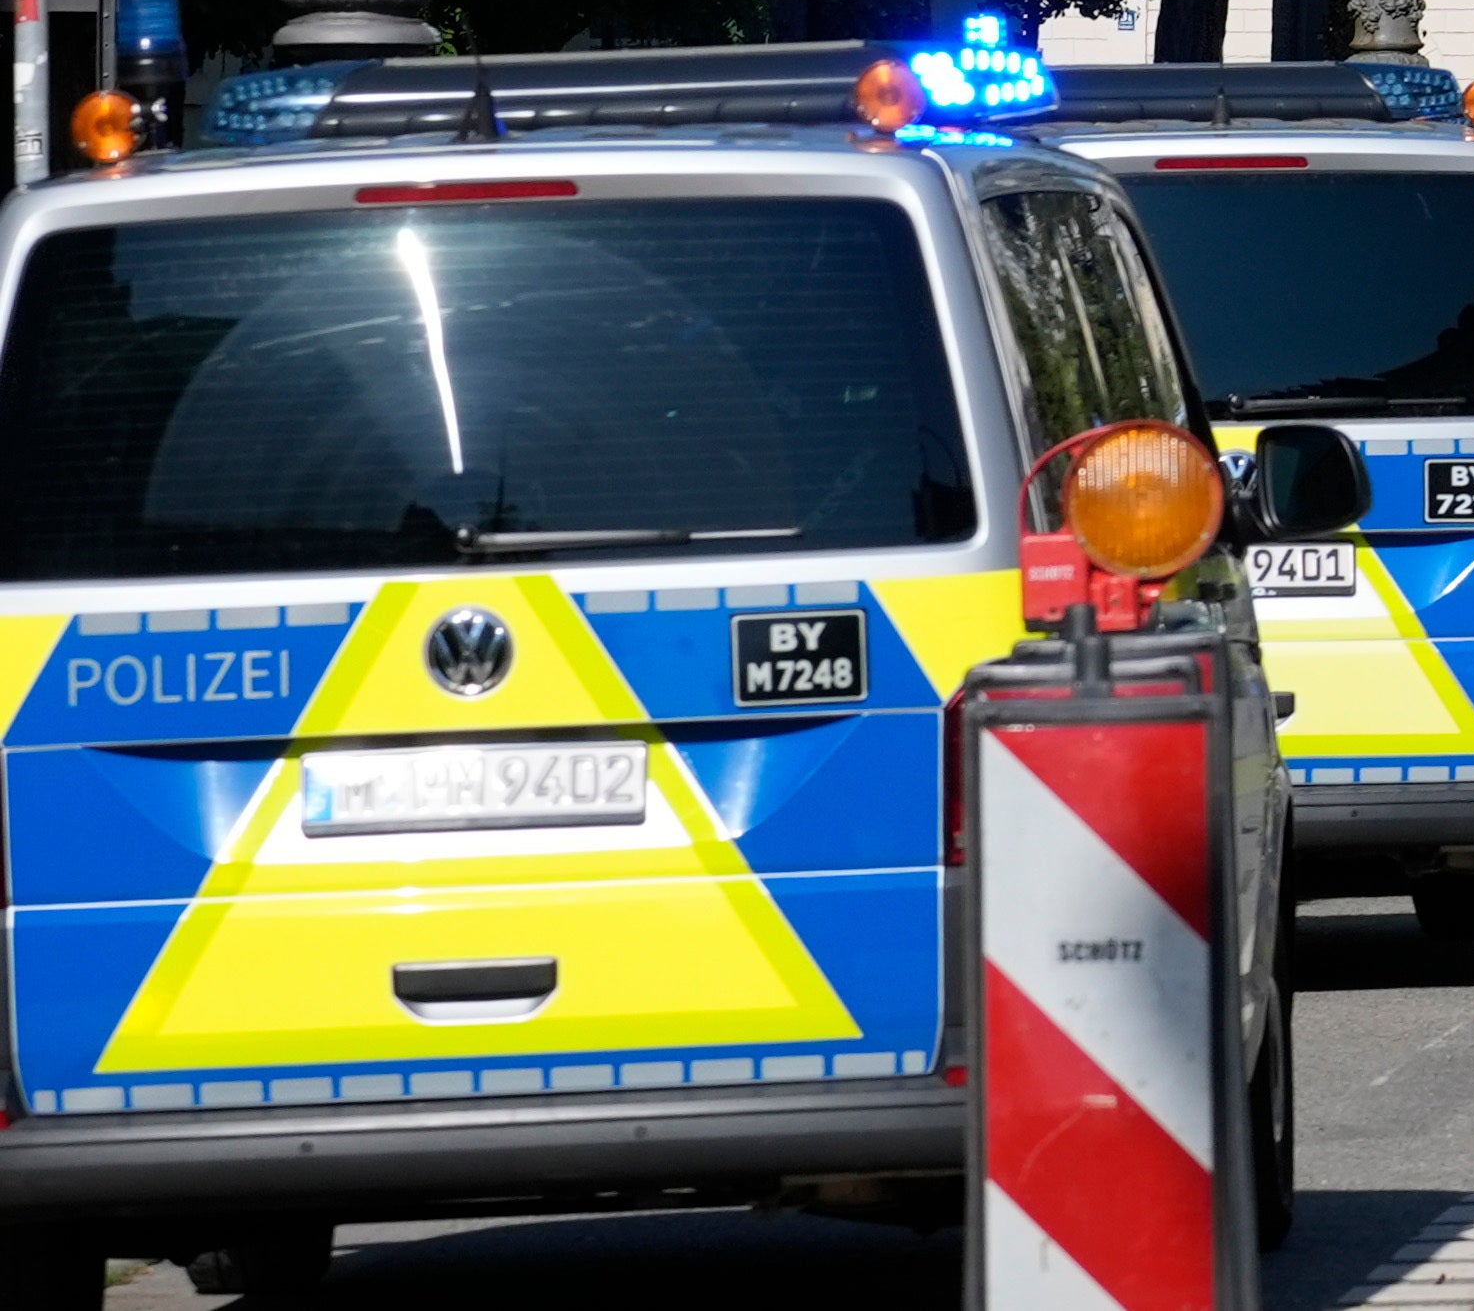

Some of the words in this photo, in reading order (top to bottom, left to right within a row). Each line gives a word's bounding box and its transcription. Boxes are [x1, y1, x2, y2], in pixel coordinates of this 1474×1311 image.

[1253, 548, 1345, 582] 9401
[769, 622, 827, 653] BY
[67, 649, 291, 708] POLIZEI
[746, 661, 773, 693] M
[775, 657, 853, 692] 7248
[500, 753, 635, 807] 9402
